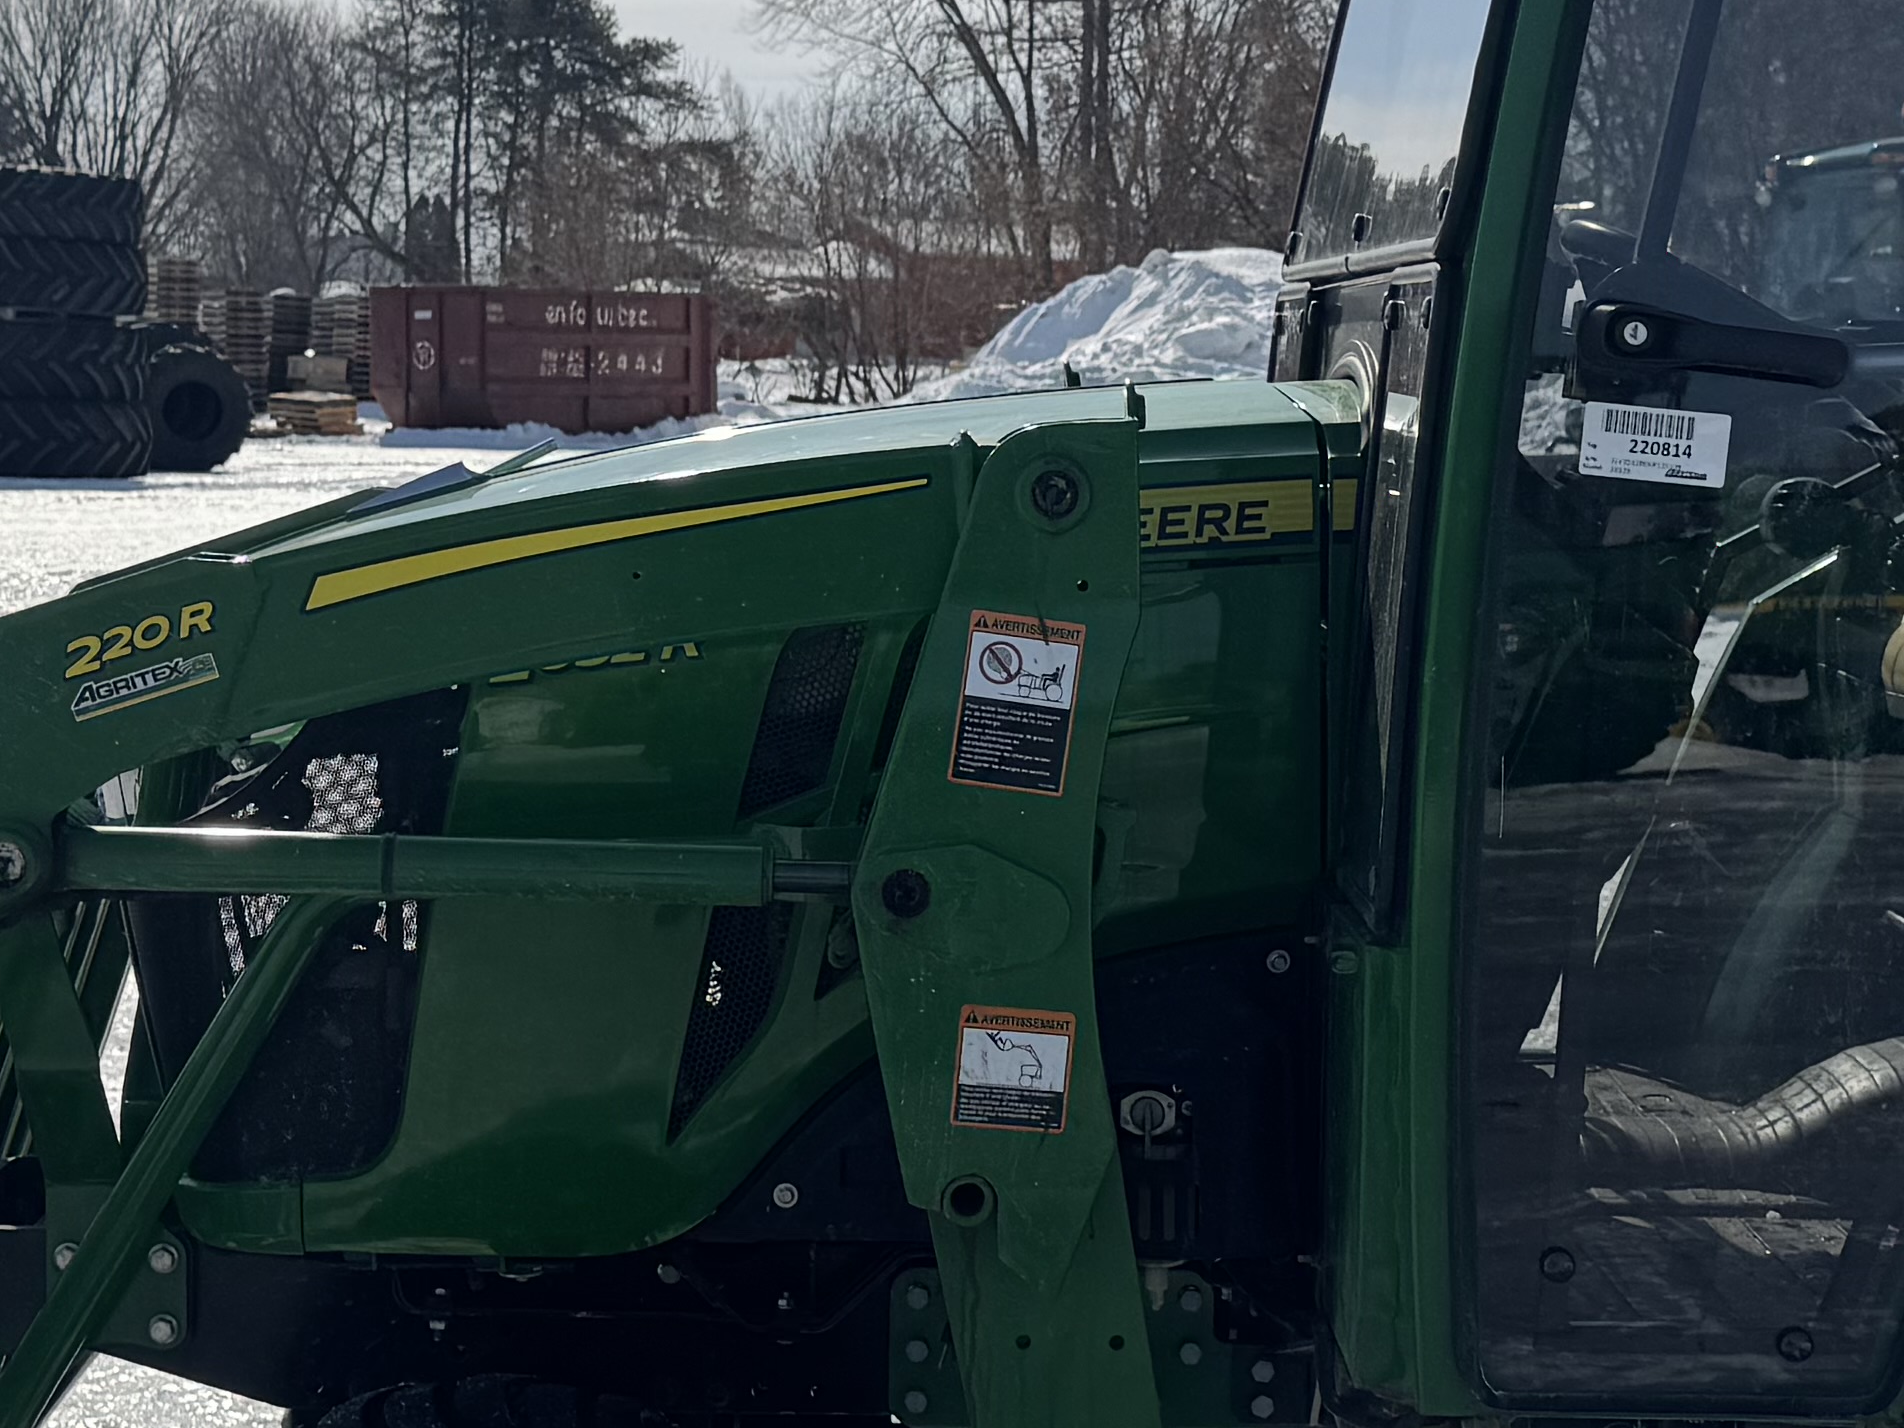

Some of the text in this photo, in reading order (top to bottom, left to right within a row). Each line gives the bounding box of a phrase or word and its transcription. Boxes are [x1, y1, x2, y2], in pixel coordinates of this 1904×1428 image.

[1629, 439, 1693, 459] 220814
[65, 603, 214, 679] 220 R
[75, 660, 183, 708] AGRITEX
